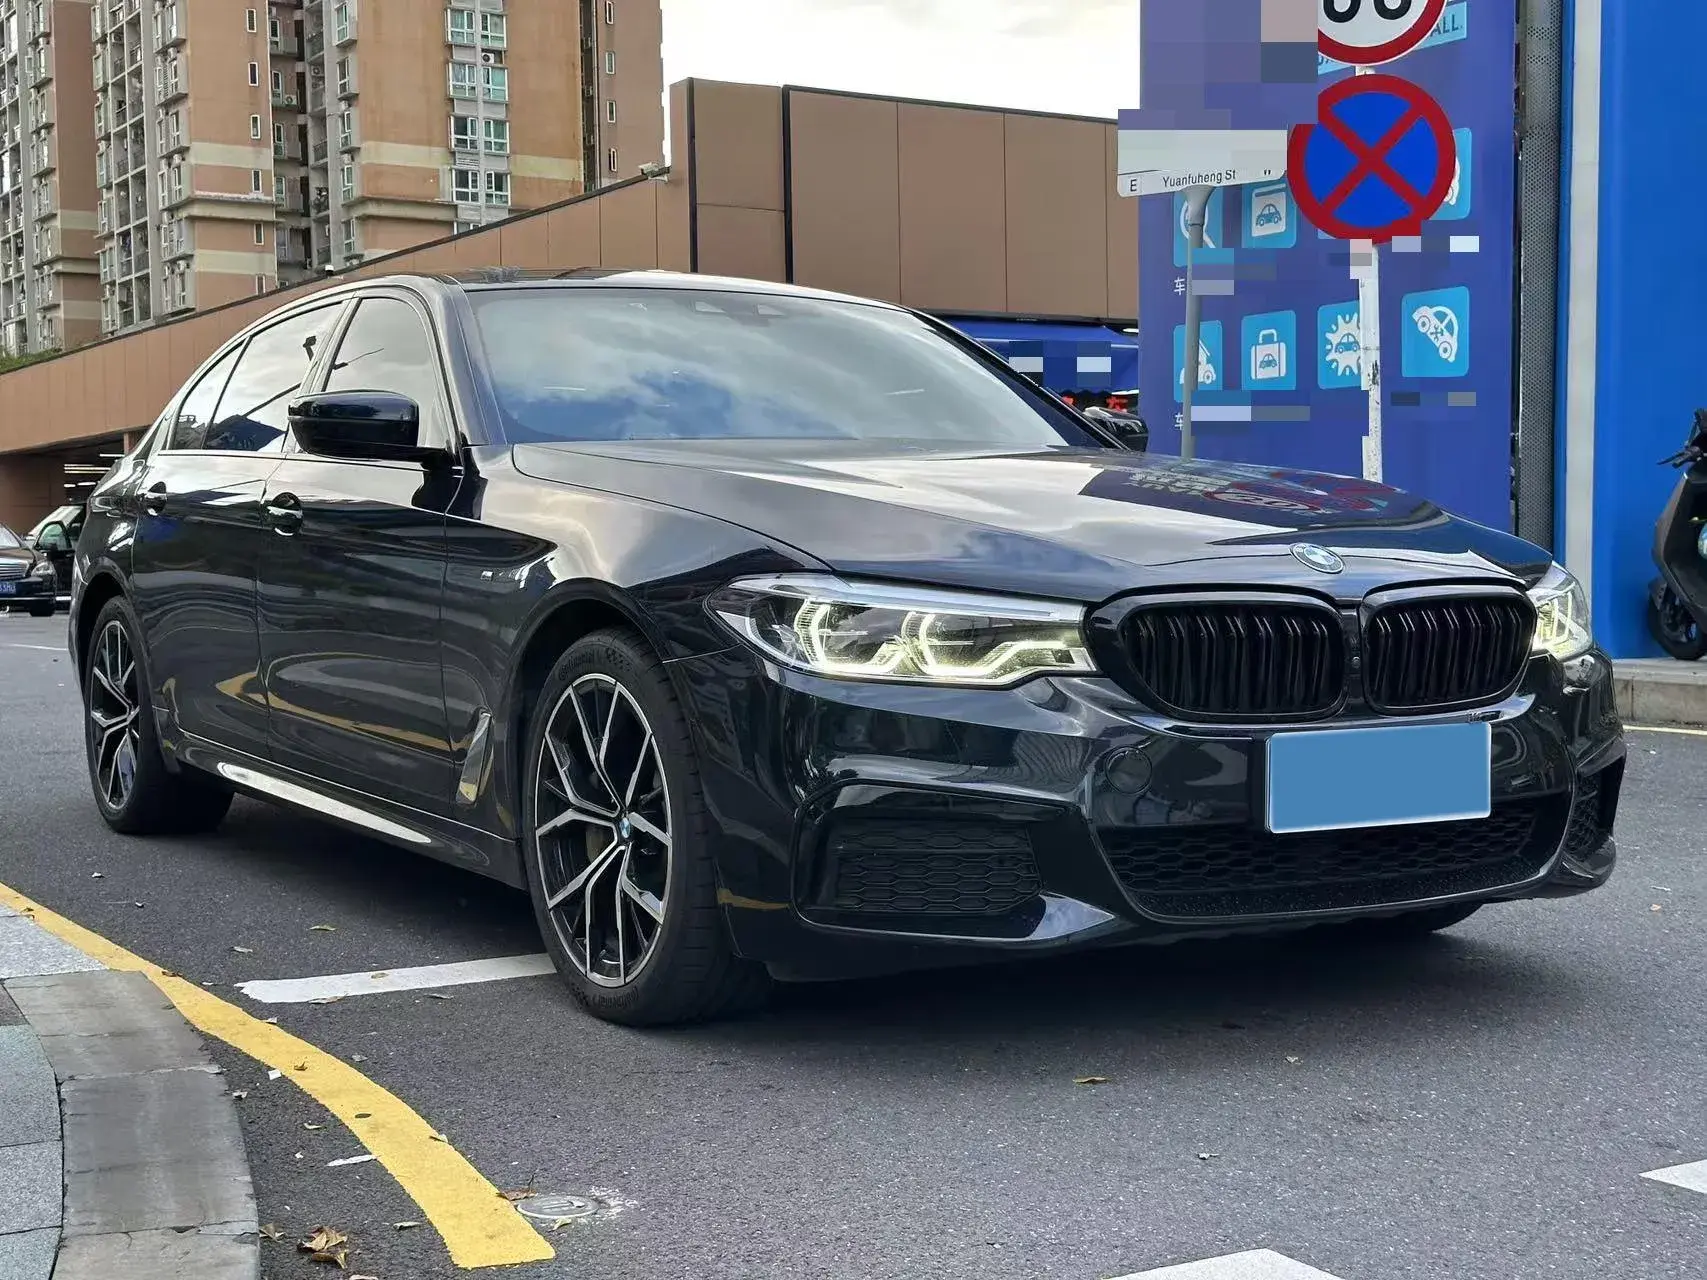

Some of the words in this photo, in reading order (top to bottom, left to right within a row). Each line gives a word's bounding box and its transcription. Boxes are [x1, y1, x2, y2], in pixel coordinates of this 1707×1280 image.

[1130, 179, 1137, 192] E
[1162, 172, 1222, 187] Yuanfuheng
[1225, 169, 1236, 180] St
